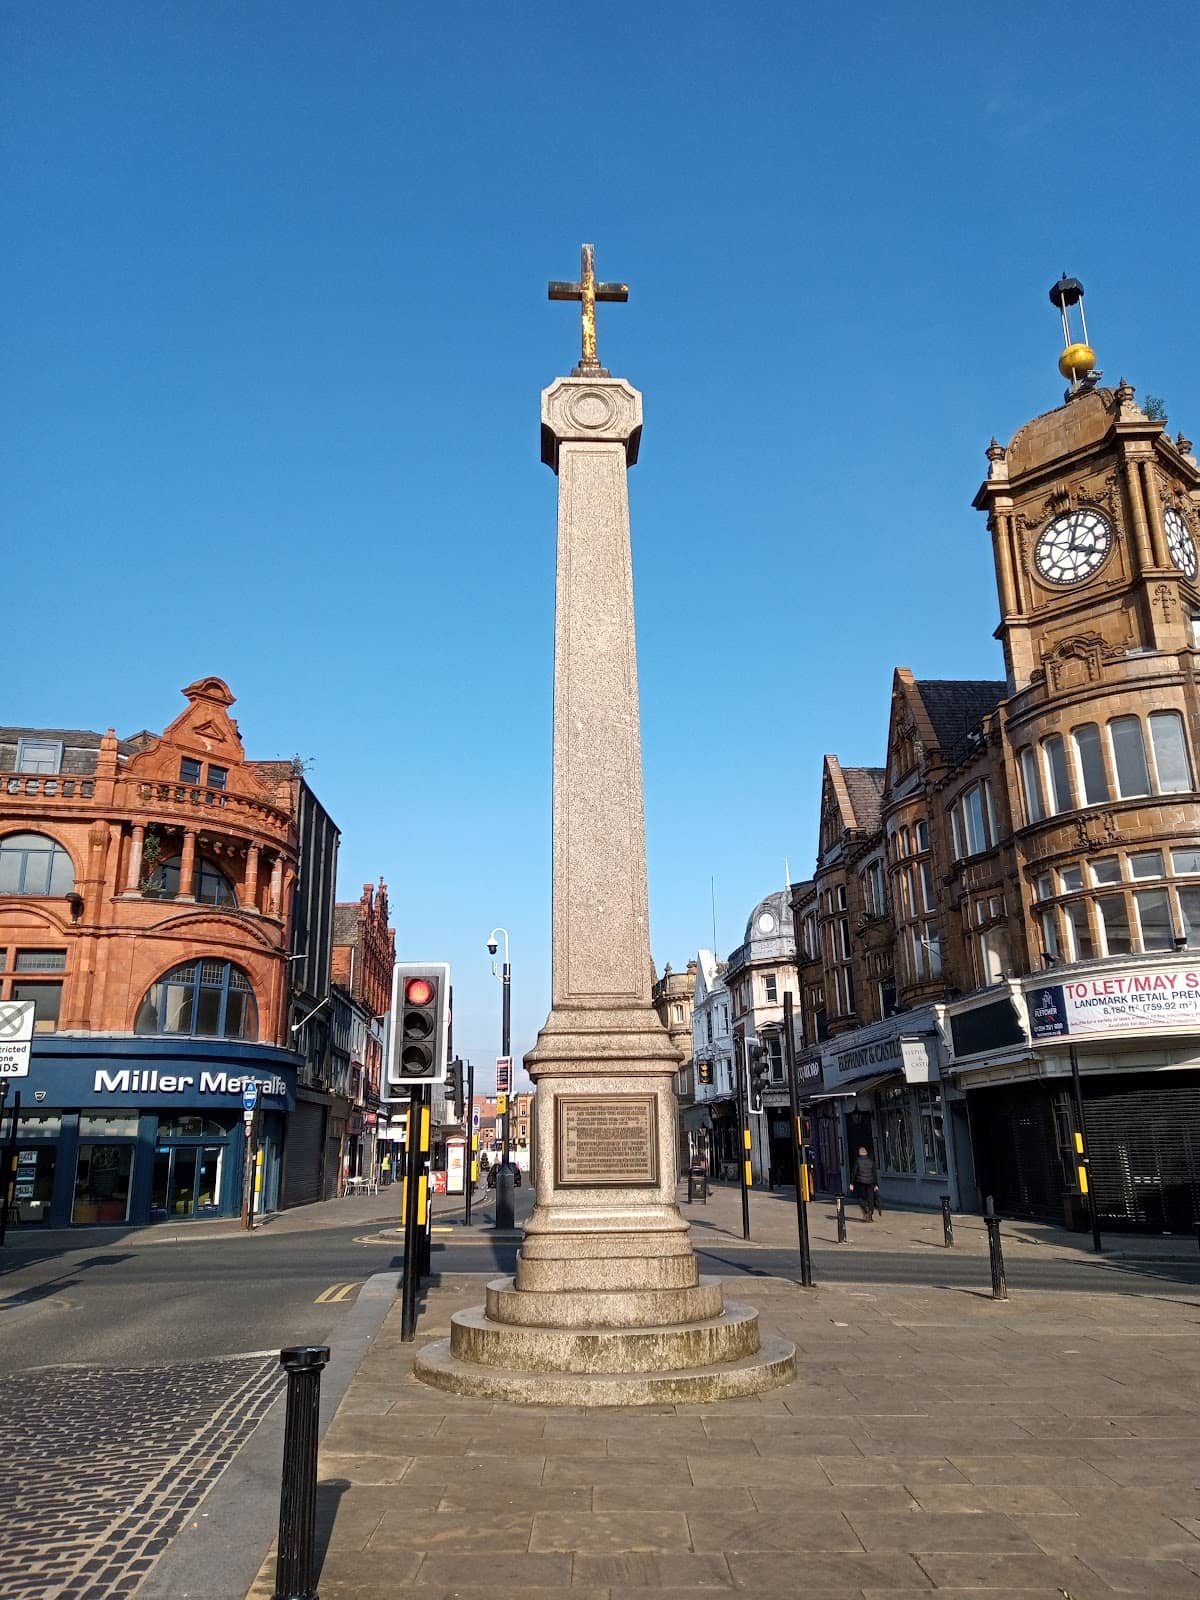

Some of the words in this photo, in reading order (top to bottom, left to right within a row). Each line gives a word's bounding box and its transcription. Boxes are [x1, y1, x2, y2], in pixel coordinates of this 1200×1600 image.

[1065, 983, 1088, 999] TO
[1092, 974, 1178, 996] LET/MAY
[1074, 995, 1128, 1009] LANDMARK
[1131, 991, 1168, 1003] RETAIL
[0, 1044, 27, 1053] ricted
[93, 1070, 193, 1092] Miller
[200, 1071, 286, 1096] Metalfe
